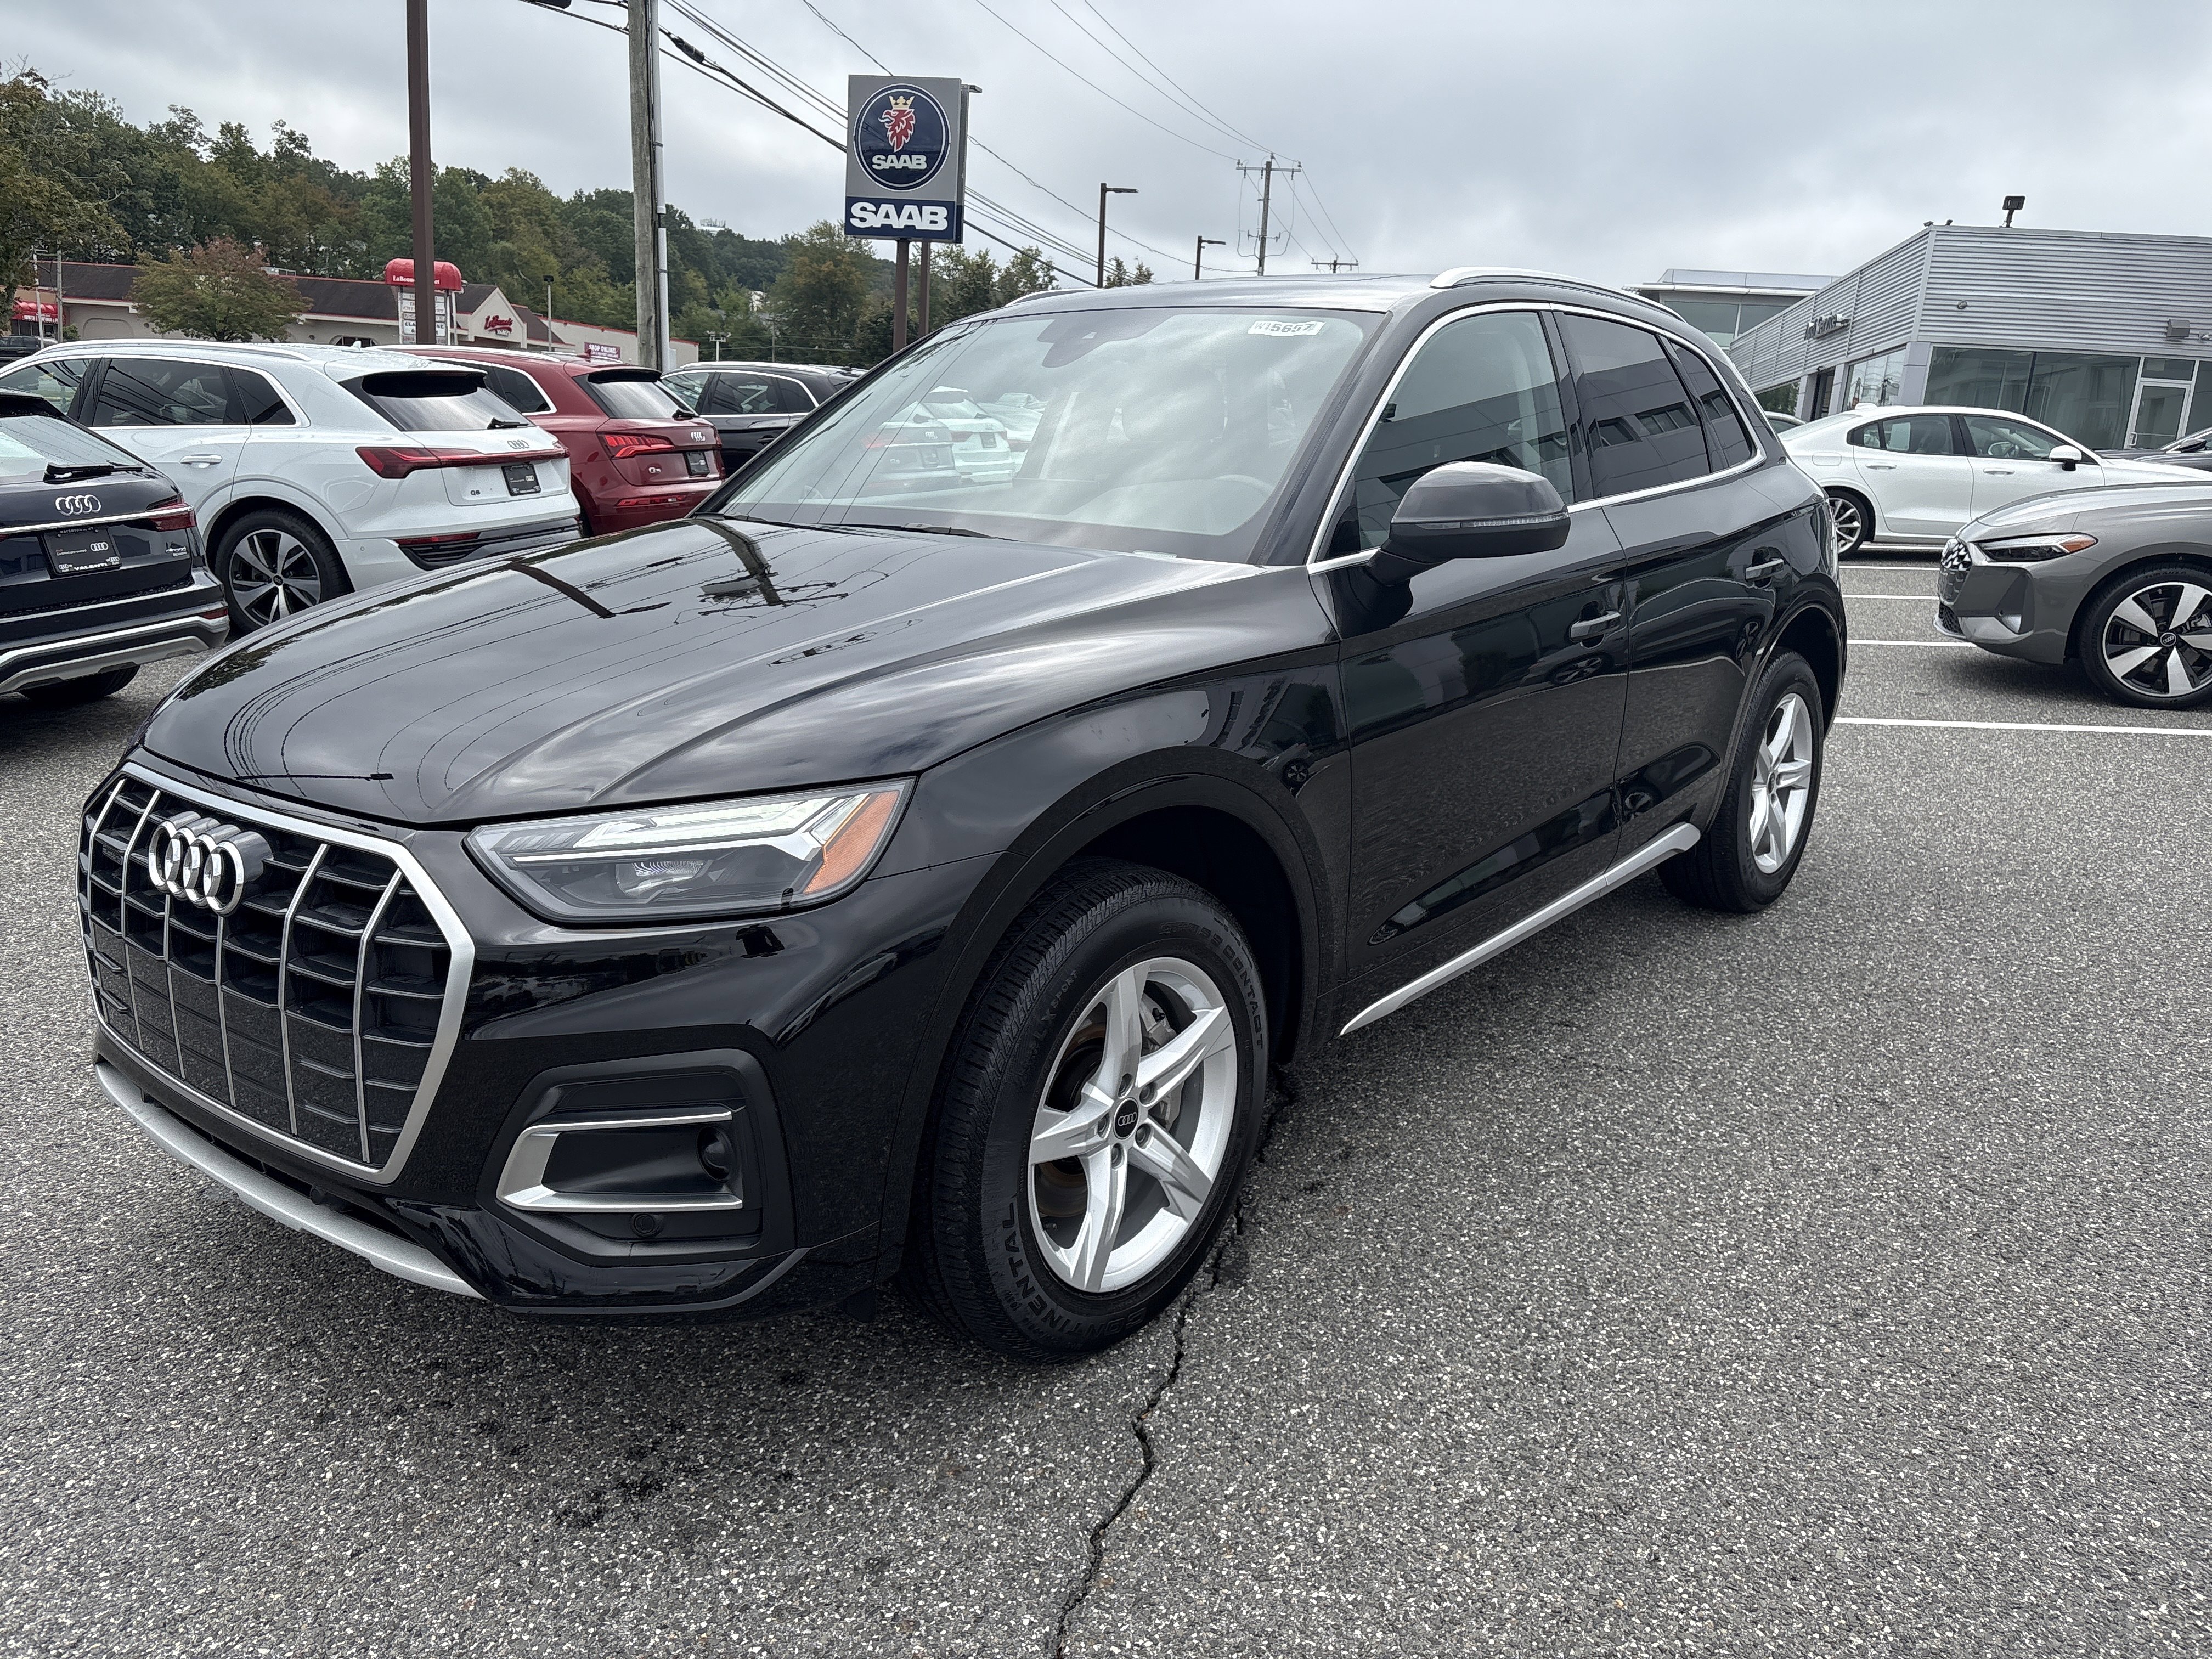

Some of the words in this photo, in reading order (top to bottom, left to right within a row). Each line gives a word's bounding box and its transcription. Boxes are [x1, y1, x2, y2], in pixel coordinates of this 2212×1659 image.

[872, 155, 927, 170] SAAB
[850, 202, 948, 230] SAAB
[74, 562, 108, 571] VALENTI
